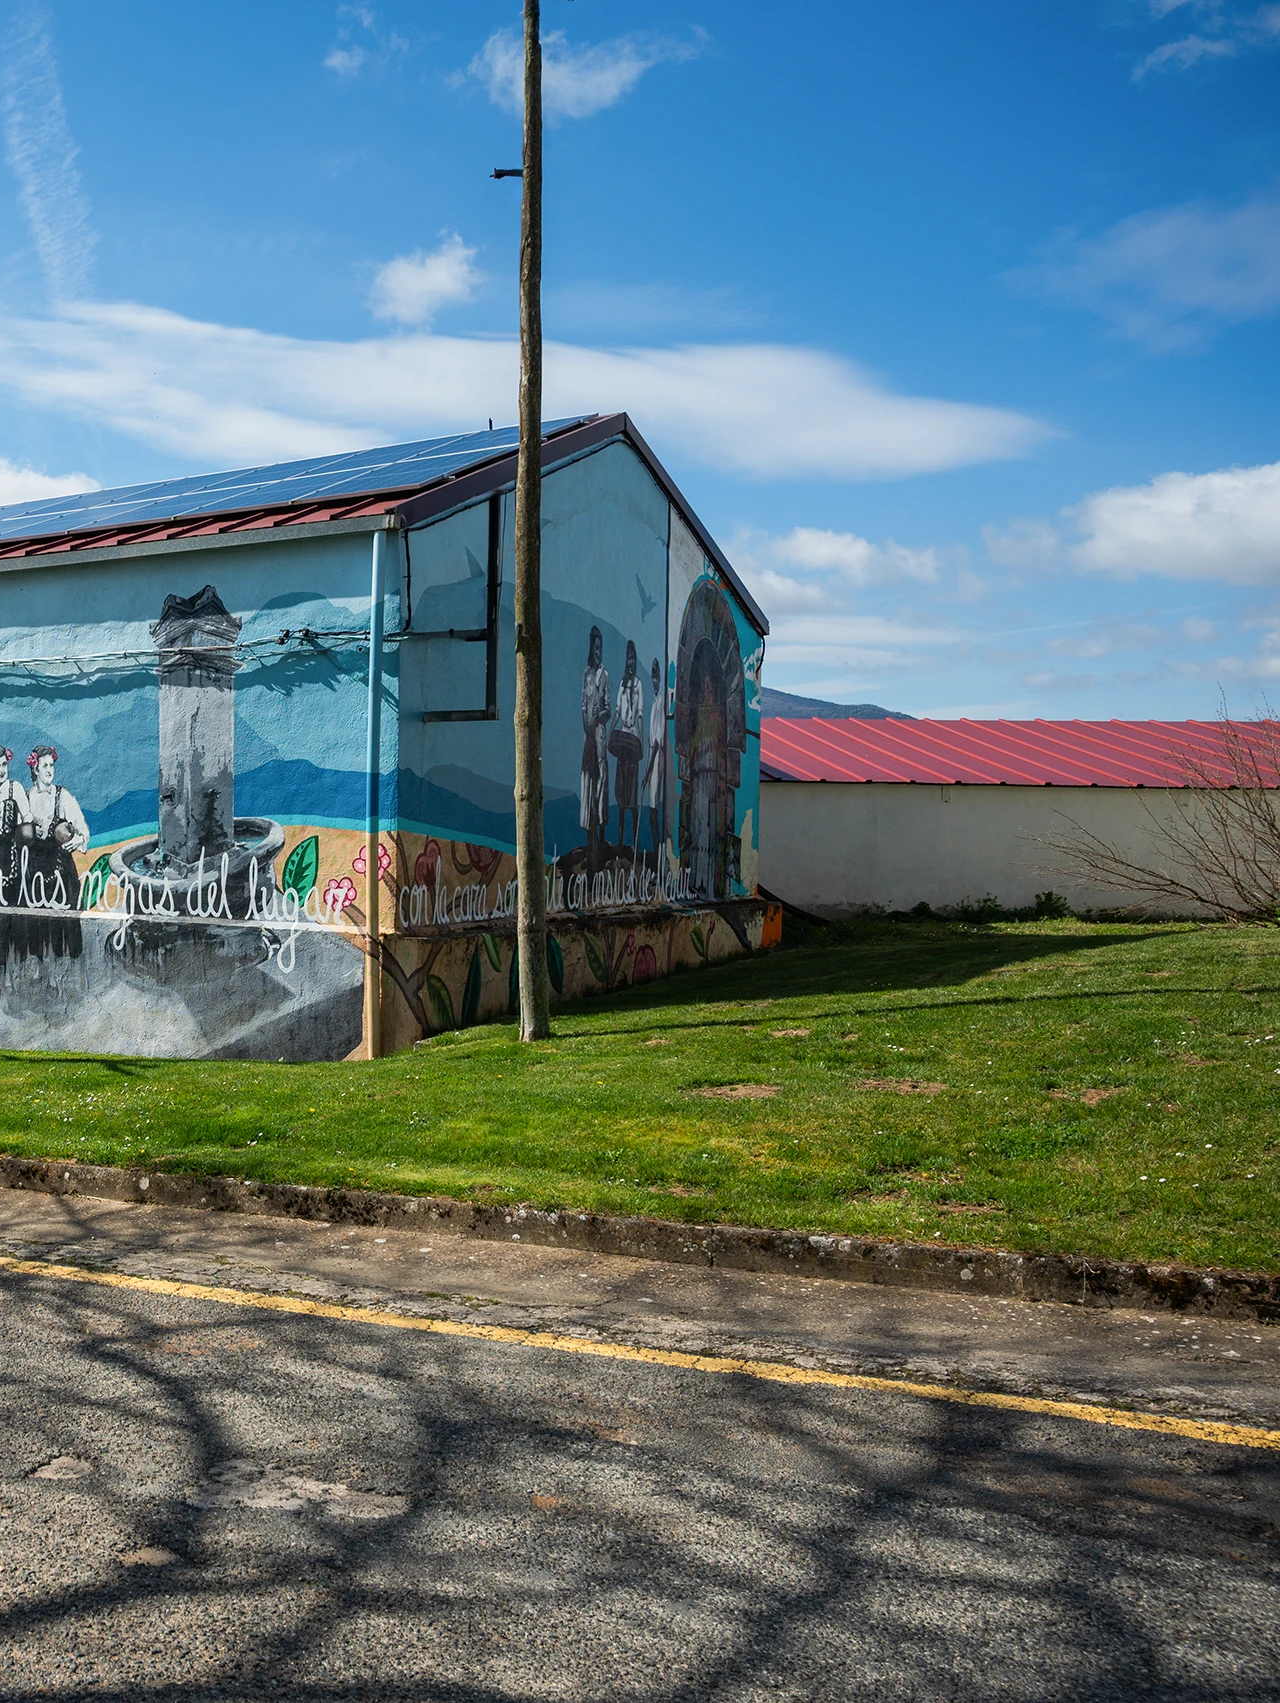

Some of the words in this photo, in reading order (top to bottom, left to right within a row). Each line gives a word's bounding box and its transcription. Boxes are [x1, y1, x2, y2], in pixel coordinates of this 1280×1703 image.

[17, 845, 71, 909] las
[187, 845, 233, 919] del
[245, 856, 347, 974] lugar
[399, 885, 429, 928] con
[432, 854, 451, 925] la
[452, 884, 489, 923] cara
[567, 873, 589, 911] con
[638, 848, 652, 904] de
